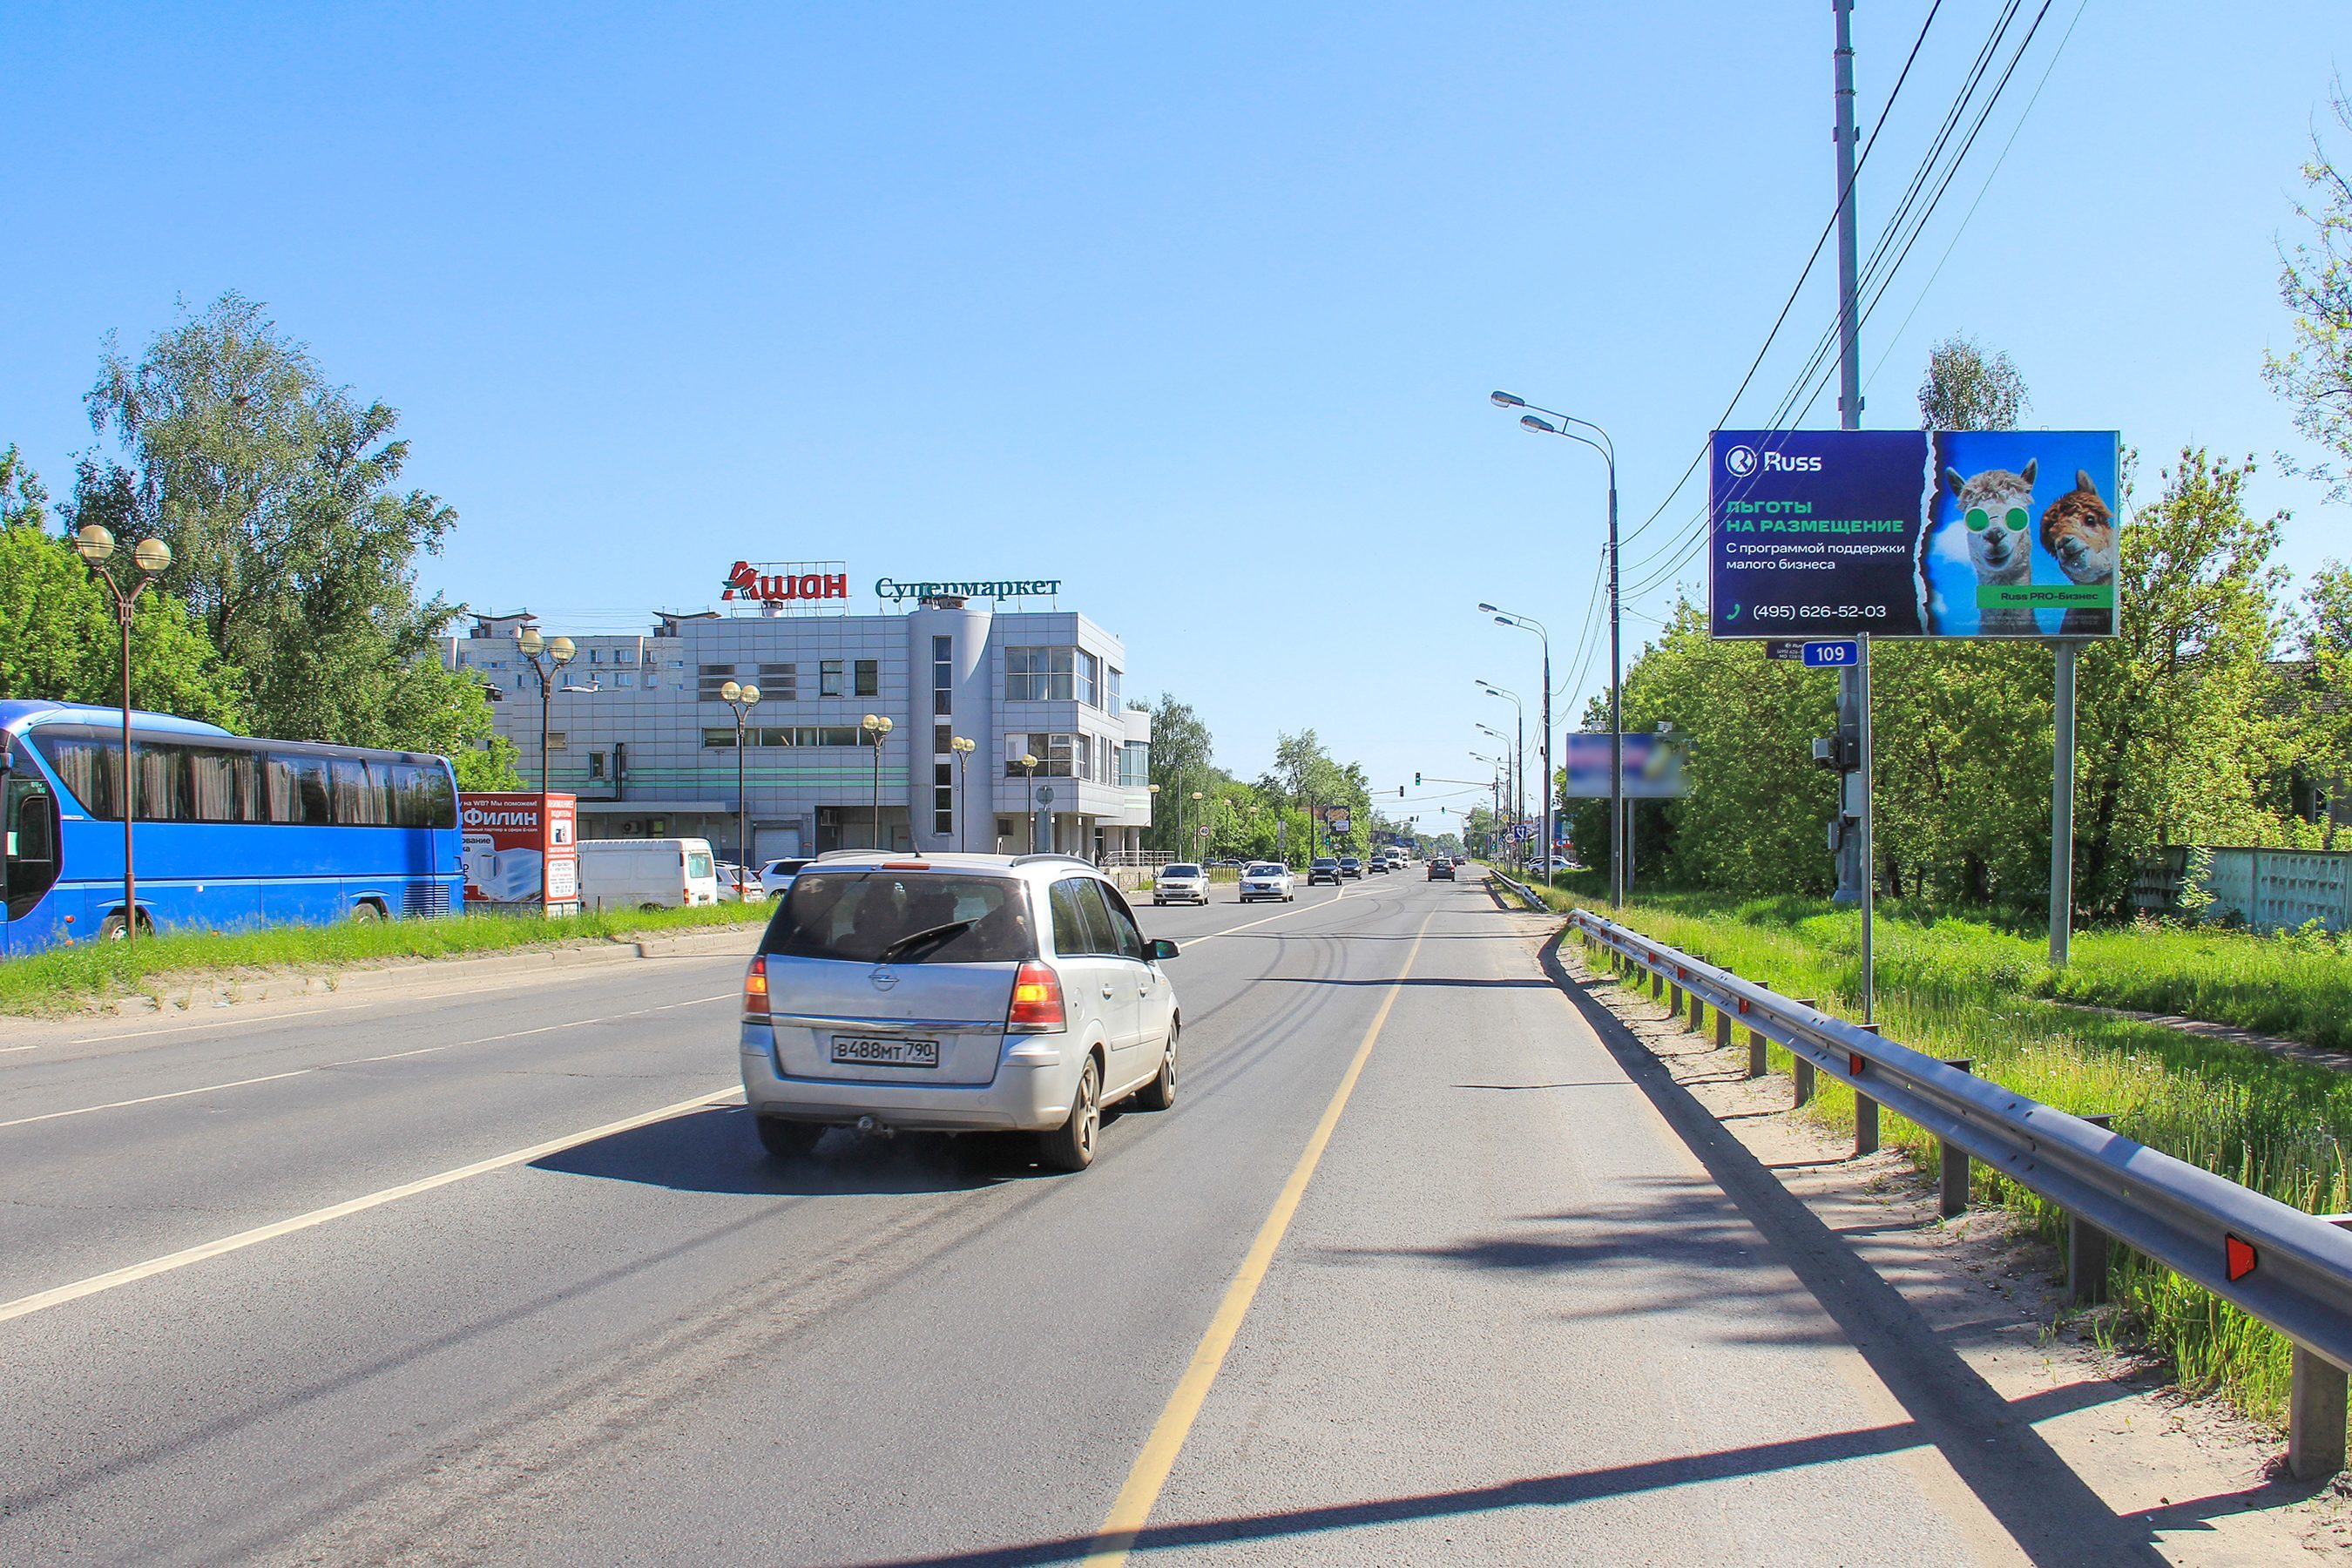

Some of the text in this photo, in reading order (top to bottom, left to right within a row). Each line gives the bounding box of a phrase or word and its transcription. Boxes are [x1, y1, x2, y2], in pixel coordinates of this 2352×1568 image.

[1764, 451, 1822, 471] Russ
[1726, 501, 1812, 514] ЛЬГОТЫ
[1726, 520, 1904, 534] НА РАЗМЕЩЕНИЕ
[1726, 543, 1905, 555] С программой поддержки
[1726, 558, 1835, 570] малого бизнеса
[721, 561, 847, 600] Ашан
[875, 578, 1061, 603] Супермаркет
[1753, 605, 1887, 620] (495) 626-52-03
[1816, 646, 1844, 661] 109
[907, 1043, 932, 1057] 790
